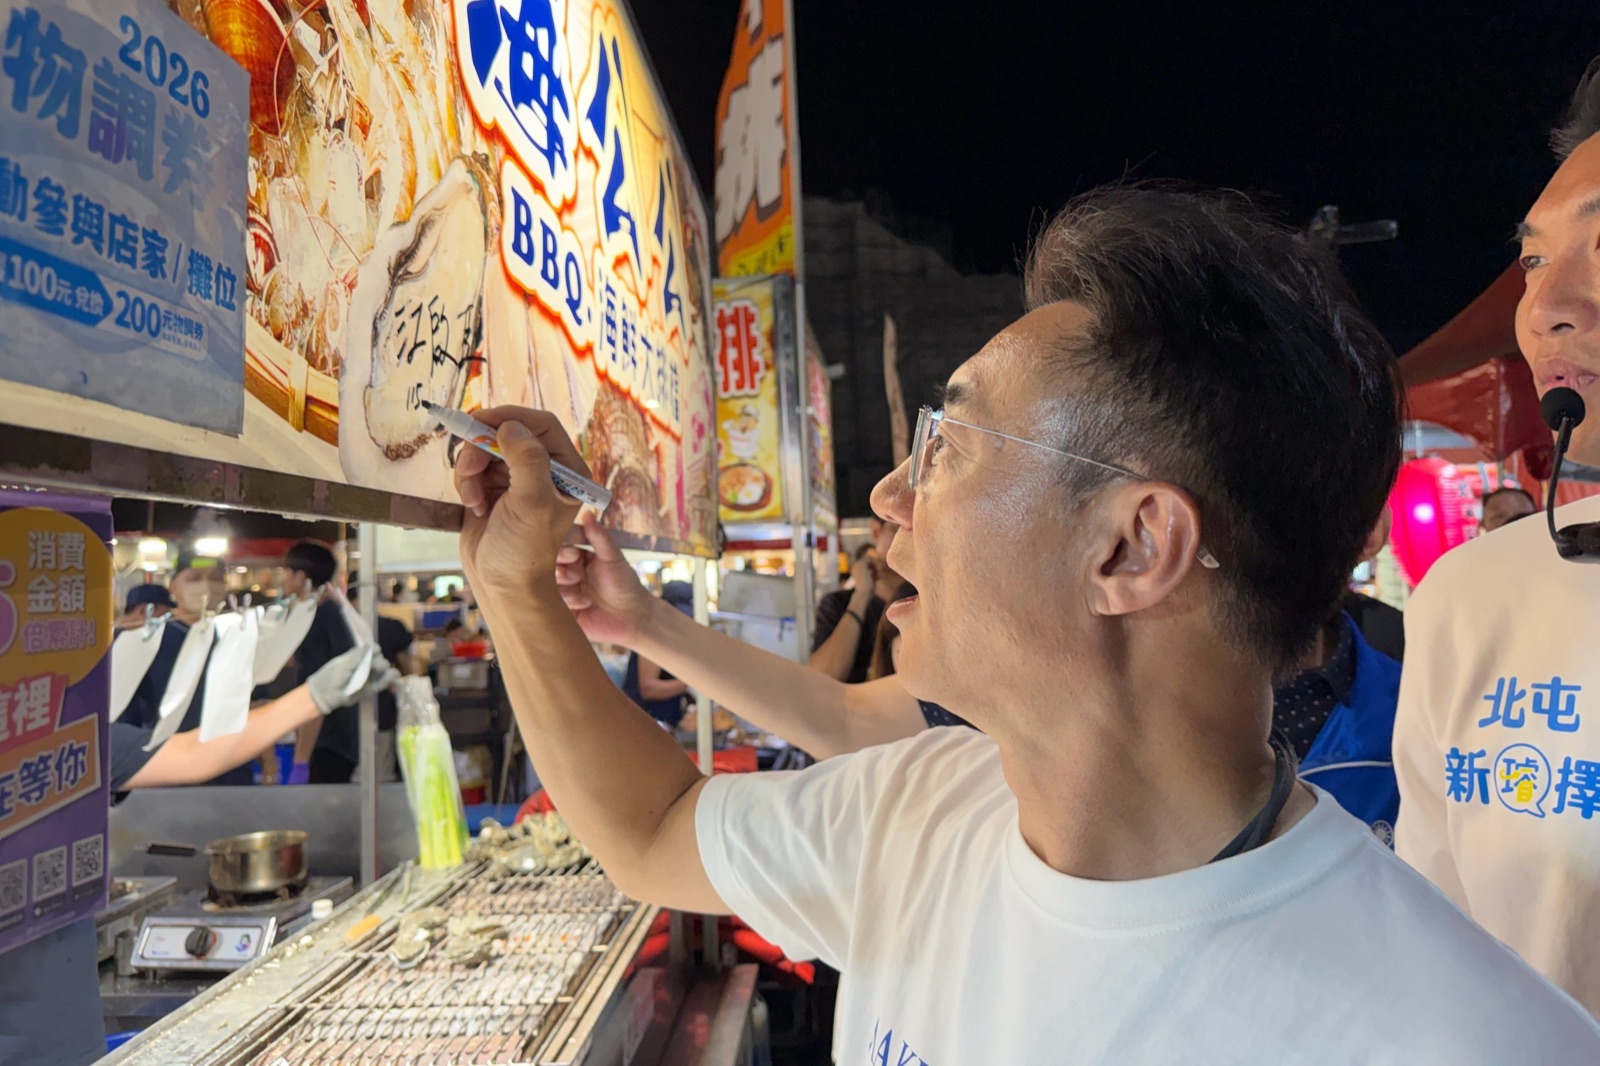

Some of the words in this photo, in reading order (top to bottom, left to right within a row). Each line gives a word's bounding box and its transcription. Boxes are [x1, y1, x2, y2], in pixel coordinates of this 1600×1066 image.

[118, 14, 211, 119] 2026
[0, 252, 72, 307] 100元
[28, 531, 86, 571] 消費
[27, 574, 86, 614] 金額
[1478, 676, 1582, 733] 北屯
